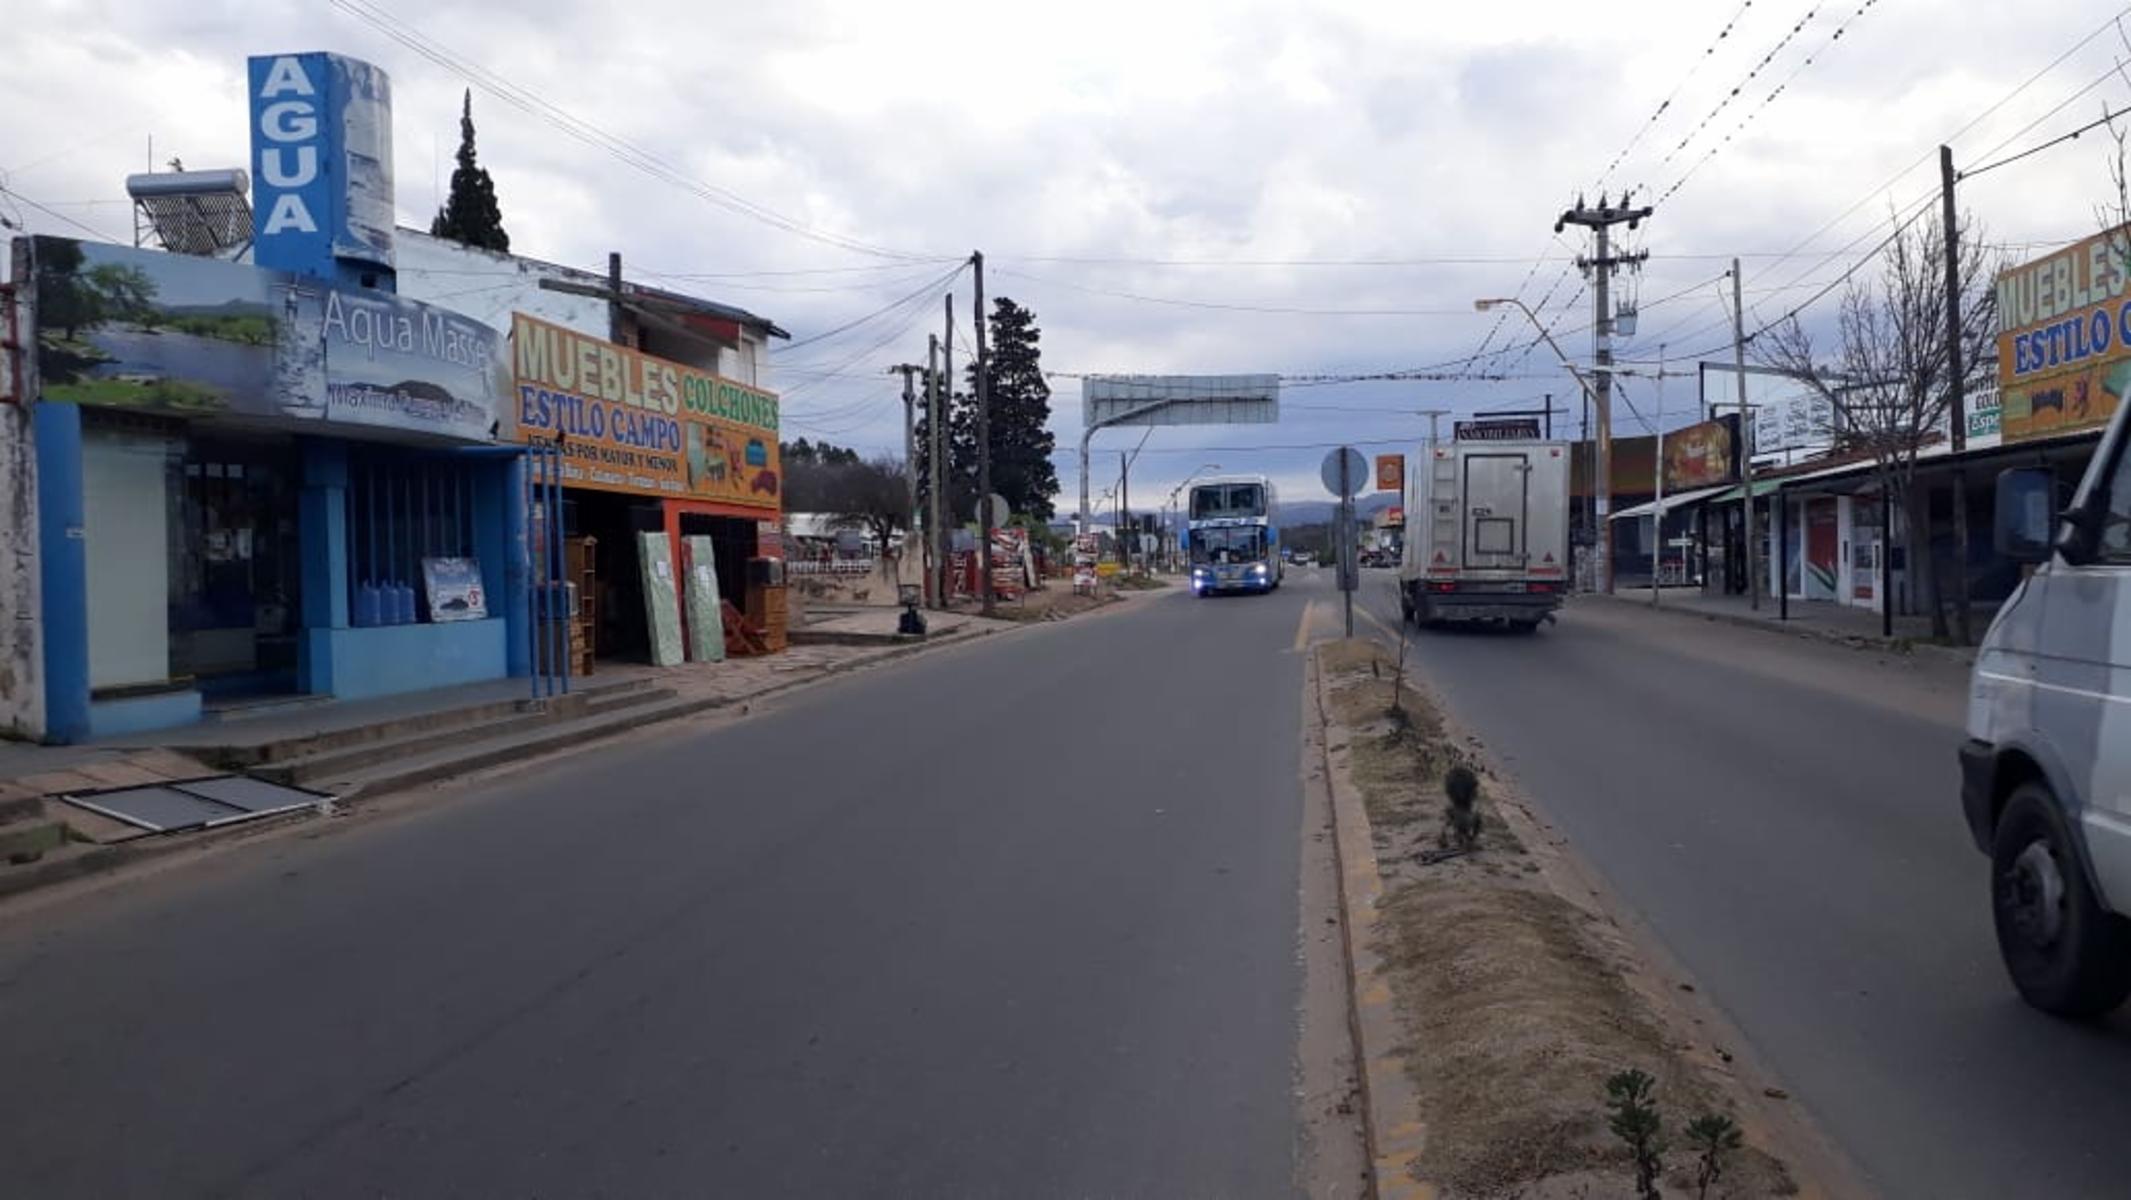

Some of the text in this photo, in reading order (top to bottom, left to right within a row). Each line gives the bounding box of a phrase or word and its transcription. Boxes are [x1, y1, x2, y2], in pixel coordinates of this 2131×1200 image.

[259, 57, 318, 235] AGUA
[1997, 231, 2125, 333] MUEBLES
[322, 289, 488, 368] Aqua Masse
[516, 318, 679, 417] MUEBLES
[2013, 307, 2112, 376] ESTILO
[519, 384, 606, 440] ESTILO
[610, 406, 681, 453] CAMPO
[682, 374, 779, 431] COLCHONES
